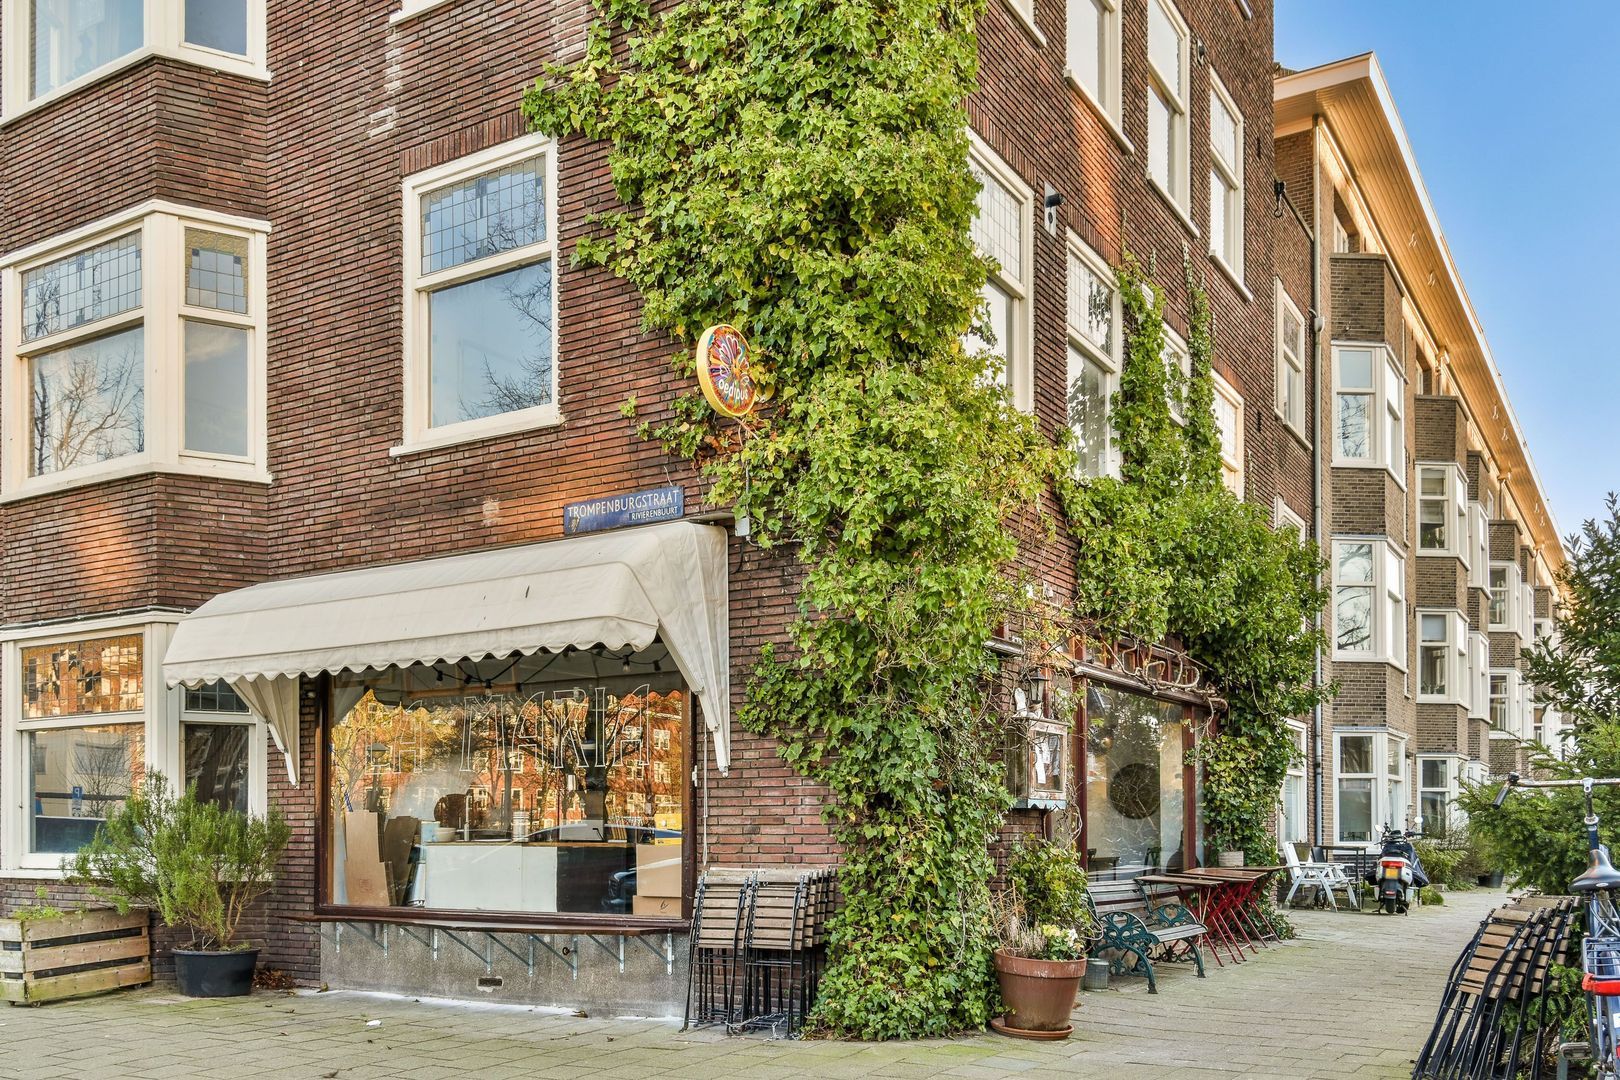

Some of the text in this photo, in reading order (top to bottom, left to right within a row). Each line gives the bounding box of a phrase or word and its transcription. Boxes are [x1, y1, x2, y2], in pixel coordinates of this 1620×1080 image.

[718, 379, 749, 401] oedipus
[568, 490, 680, 518] TROMPENBURGSTRAAT
[631, 506, 678, 520] RIVIERENBUURT
[459, 683, 650, 772] MARIA
